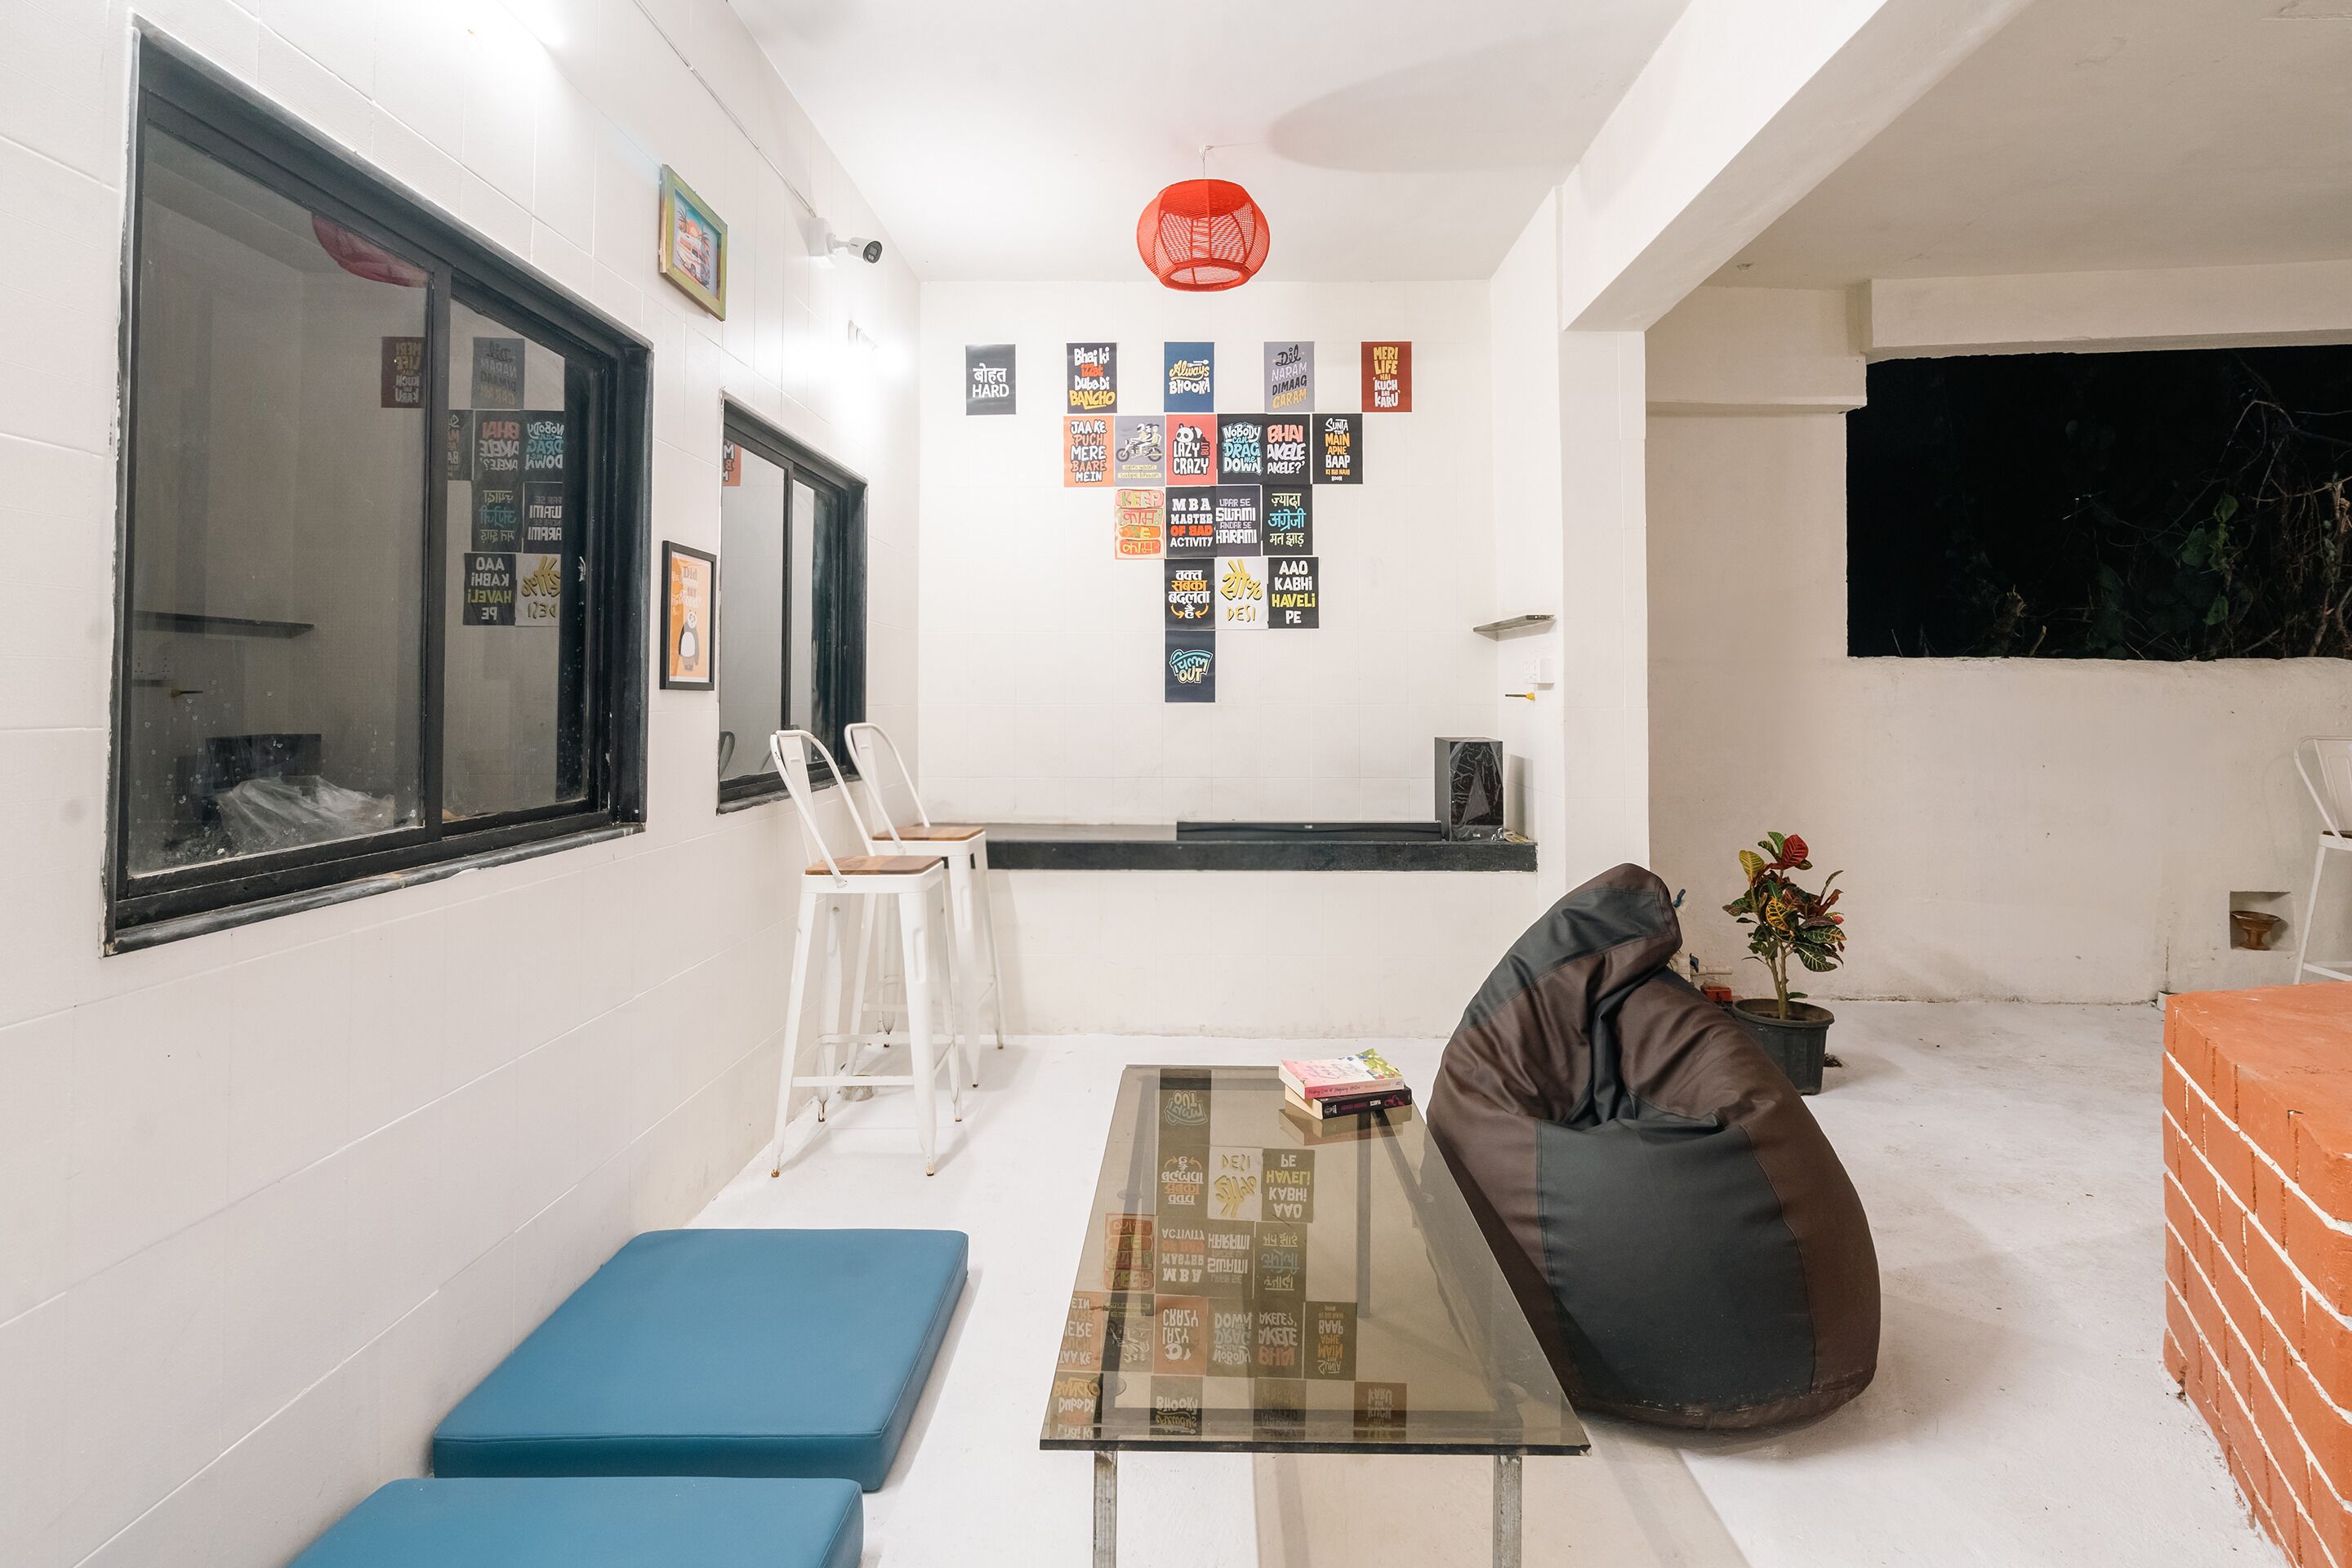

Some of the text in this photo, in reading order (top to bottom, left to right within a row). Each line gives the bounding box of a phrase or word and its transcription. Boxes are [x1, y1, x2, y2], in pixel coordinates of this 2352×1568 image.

[1074, 346, 1110, 366] Bhai ki
[1276, 345, 1301, 366] Dil
[1373, 346, 1398, 360] MERI
[973, 363, 1007, 384] बोहत
[1169, 360, 1209, 379] Always
[1271, 362, 1307, 381] NARAM
[1374, 360, 1398, 375] LIFE
[972, 384, 1009, 398] HARD
[1169, 377, 1210, 394] BHOOKA
[1272, 375, 1307, 395] DIMAAG
[1069, 390, 1116, 409] BANCHO
[1272, 389, 1307, 409] GARAM
[1071, 419, 1107, 434] JAA KE
[1325, 418, 1348, 431] SUNTA
[1074, 434, 1103, 447] PUCH
[1267, 425, 1303, 443] BHAI
[1325, 433, 1350, 447] MAIN
[1071, 445, 1107, 461] MERE
[1174, 441, 1200, 457] LAZY
[1200, 442, 1209, 456] BUT
[1223, 443, 1260, 458] DRAG
[1267, 443, 1306, 461] AKELE
[1328, 446, 1347, 455] APNE
[1071, 460, 1107, 472] BAARE
[1174, 457, 1209, 474] CRAZY
[1225, 457, 1261, 473] DOWN
[1325, 455, 1350, 468] BAAP
[1075, 471, 1102, 483] MEIN
[1121, 491, 1160, 506] KEEP
[1240, 498, 1251, 506] SE
[1123, 510, 1157, 524] काम
[1171, 514, 1213, 524] MASTER
[1216, 507, 1255, 521] SWAMI
[1132, 526, 1150, 538] SE
[1170, 525, 1213, 536] OF BAD
[1216, 529, 1257, 544] HARAMI
[1170, 537, 1213, 547] ACTIVITY
[1270, 532, 1285, 546] मत
[1123, 541, 1153, 554] काम
[1279, 560, 1307, 575] AAO
[1175, 570, 1203, 581] वक्त
[1171, 580, 1208, 591] सबका
[1169, 590, 1210, 604] बदलता
[1184, 604, 1195, 619] है
[1227, 606, 1256, 621] DESI
[1285, 610, 1302, 624] PE
[1179, 666, 1202, 681] OUT
